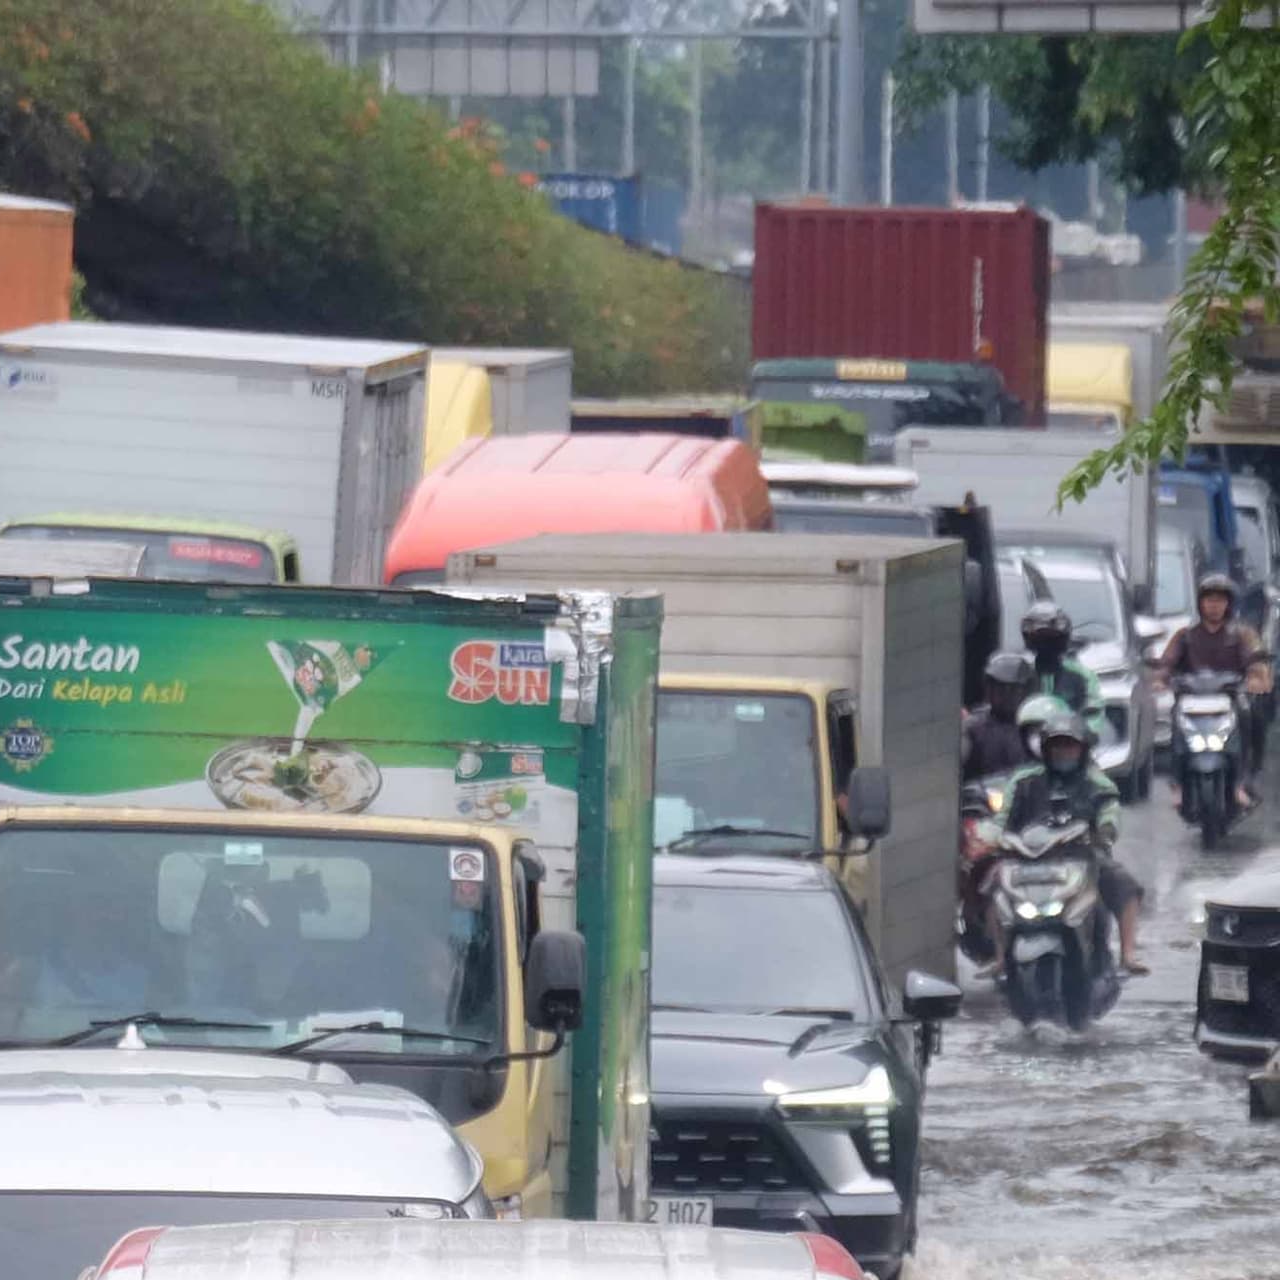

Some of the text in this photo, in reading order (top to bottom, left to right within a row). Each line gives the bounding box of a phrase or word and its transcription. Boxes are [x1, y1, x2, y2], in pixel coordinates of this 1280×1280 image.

[503, 645, 544, 664] kara
[52, 678, 133, 708] Kelapa
[141, 679, 188, 704] Asli
[11, 735, 40, 747] TOP
